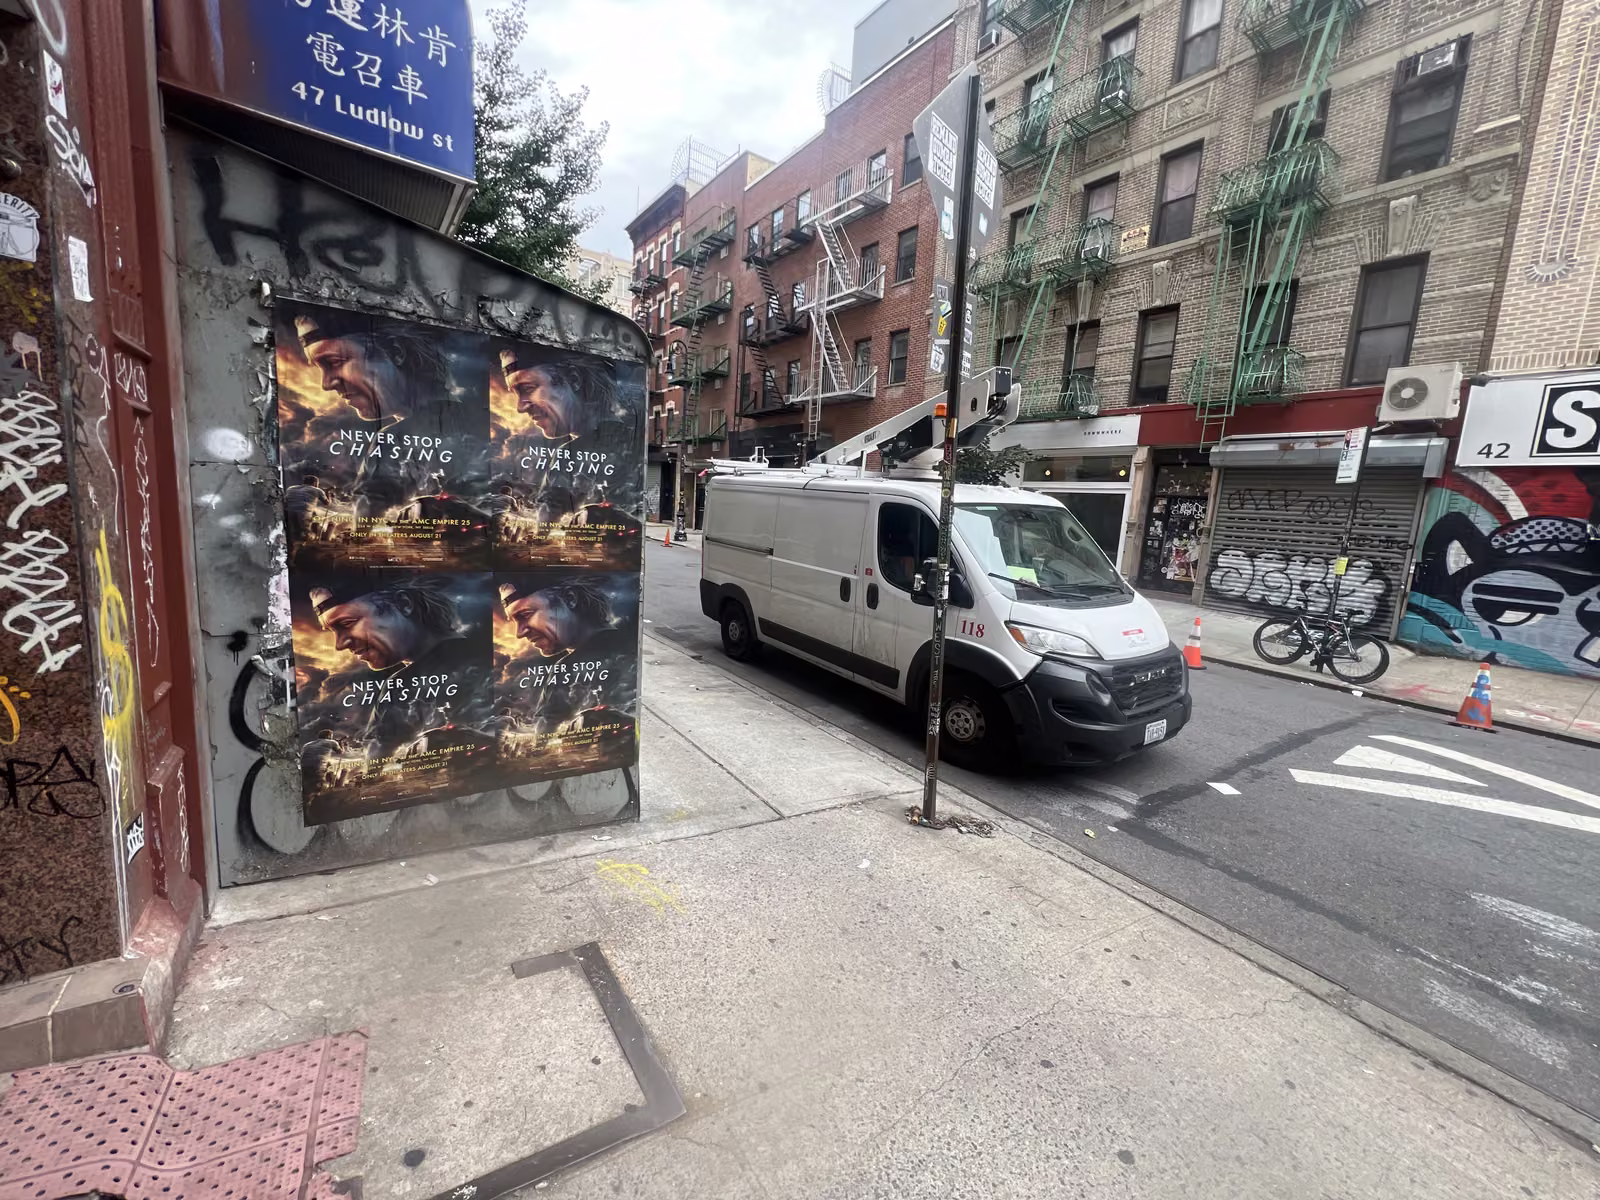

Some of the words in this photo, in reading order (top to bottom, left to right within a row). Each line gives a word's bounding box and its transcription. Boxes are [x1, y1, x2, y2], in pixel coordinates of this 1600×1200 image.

[295, 0, 456, 67] 運林肯
[306, 32, 428, 105] 電召車
[291, 82, 325, 106] 47
[335, 94, 424, 140] Ludlow
[432, 132, 454, 151] st
[0, 193, 38, 218] ERITY
[340, 428, 395, 445] NEVER
[403, 434, 442, 449] STOP
[329, 441, 453, 463] CHASING
[529, 446, 571, 460] NEVER
[576, 451, 607, 463] STOP
[1476, 442, 1511, 459] 42
[520, 456, 615, 476] CHASING
[358, 516, 369, 524] IN
[411, 517, 430, 525] AMC
[432, 518, 459, 526] EMPIRE
[461, 519, 471, 527] 25
[595, 523, 617, 531] EMPIRE
[960, 619, 985, 639] 118
[527, 664, 567, 676] NEVER
[572, 660, 602, 672] STOP
[352, 678, 404, 693] NEVER
[411, 674, 448, 687] STOP
[519, 669, 609, 689] CHASING
[342, 683, 458, 707] CHASING
[576, 726, 591, 734] AMC
[591, 723, 612, 732] EMPIRE
[369, 758, 379, 766] IN
[439, 745, 464, 754] EMPIRE
[417, 762, 442, 771] AUGUST
